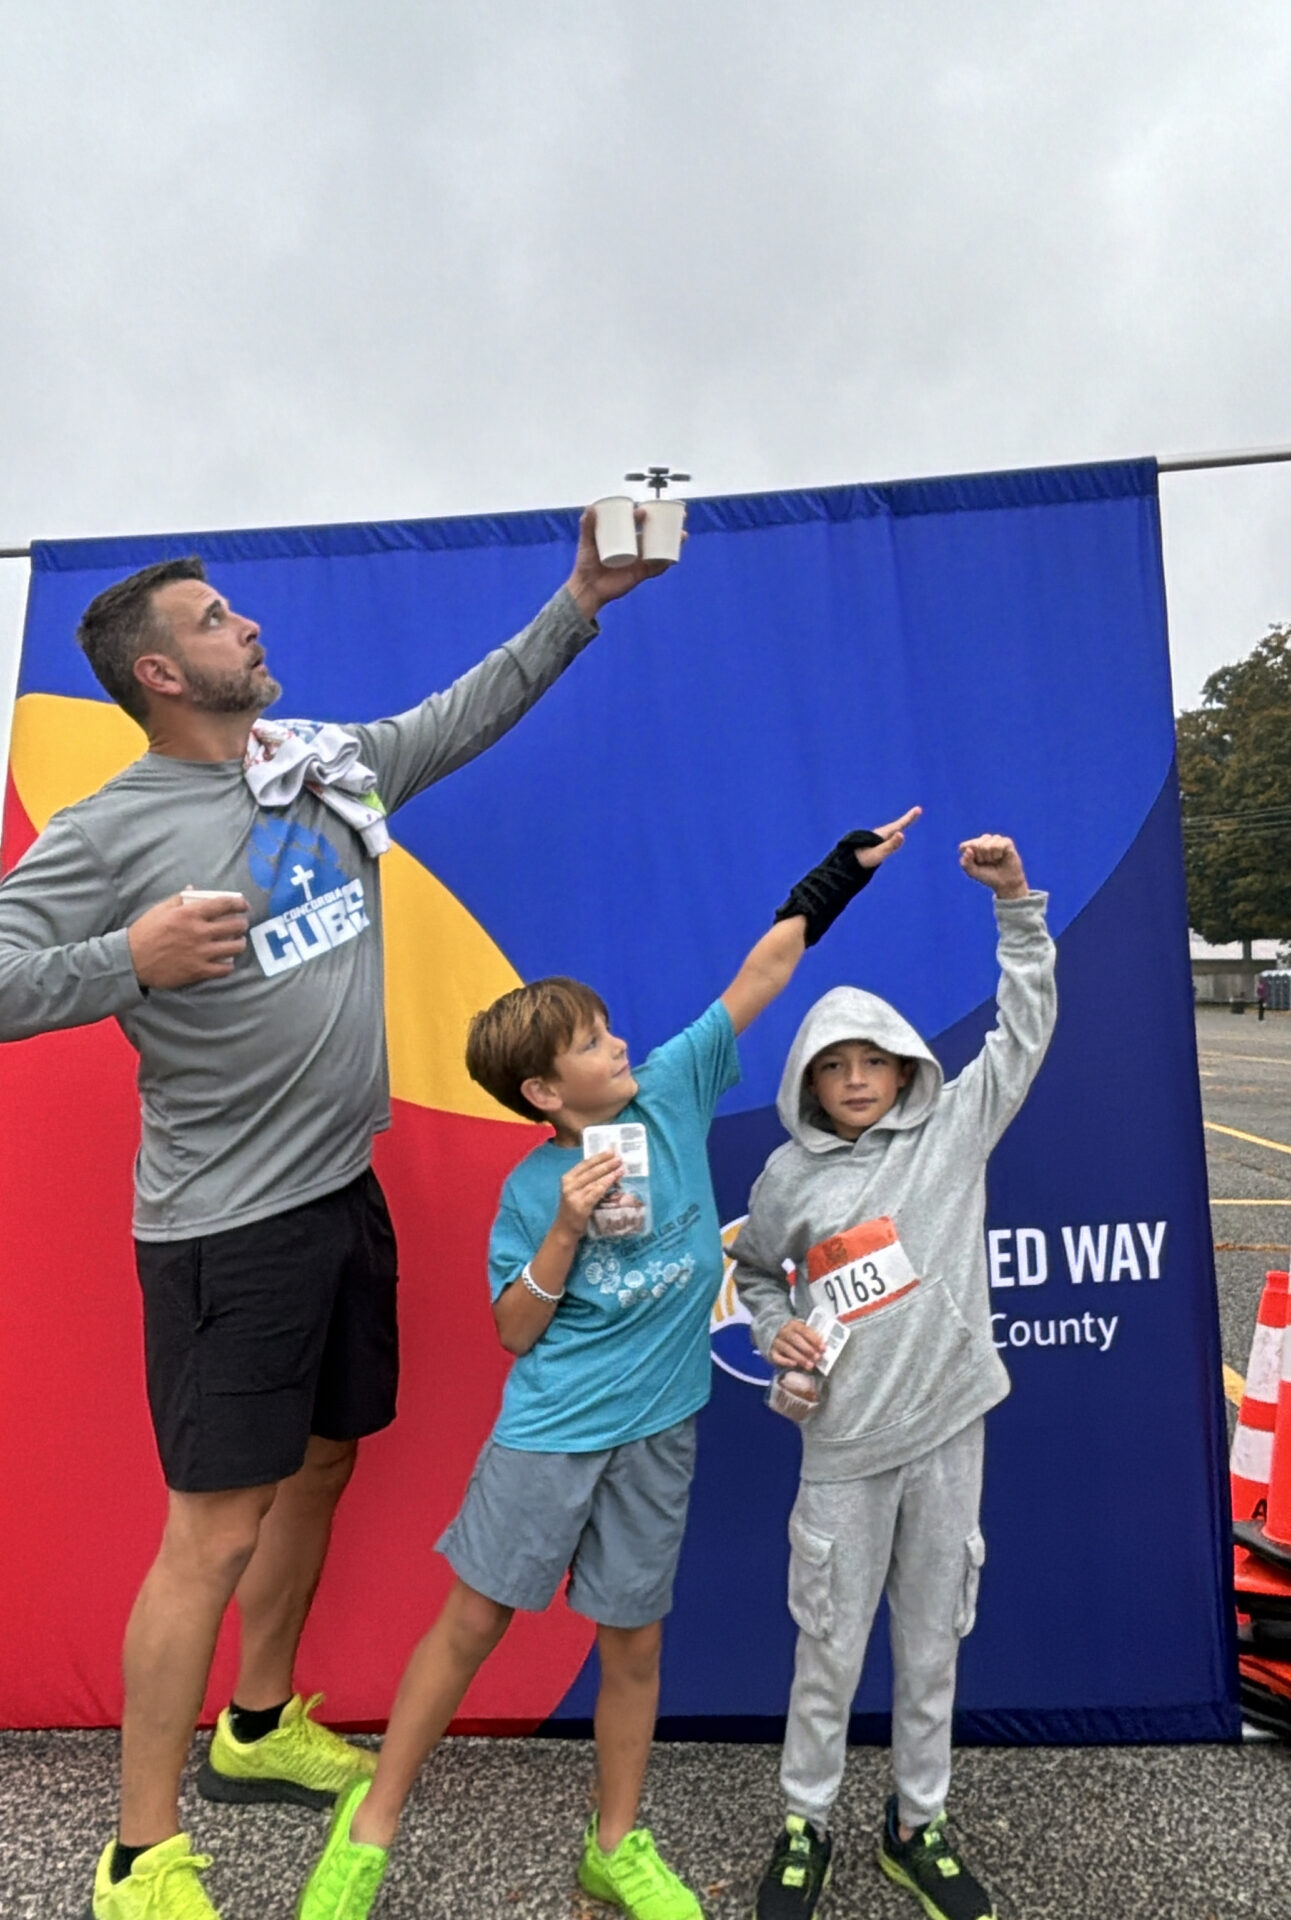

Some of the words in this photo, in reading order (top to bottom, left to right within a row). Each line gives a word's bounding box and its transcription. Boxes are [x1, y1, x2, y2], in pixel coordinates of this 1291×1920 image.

[988, 1228, 1048, 1288] ED
[1061, 1221, 1167, 1284] WAY
[823, 1261, 887, 1315] 9163
[991, 1311, 1119, 1352] County
